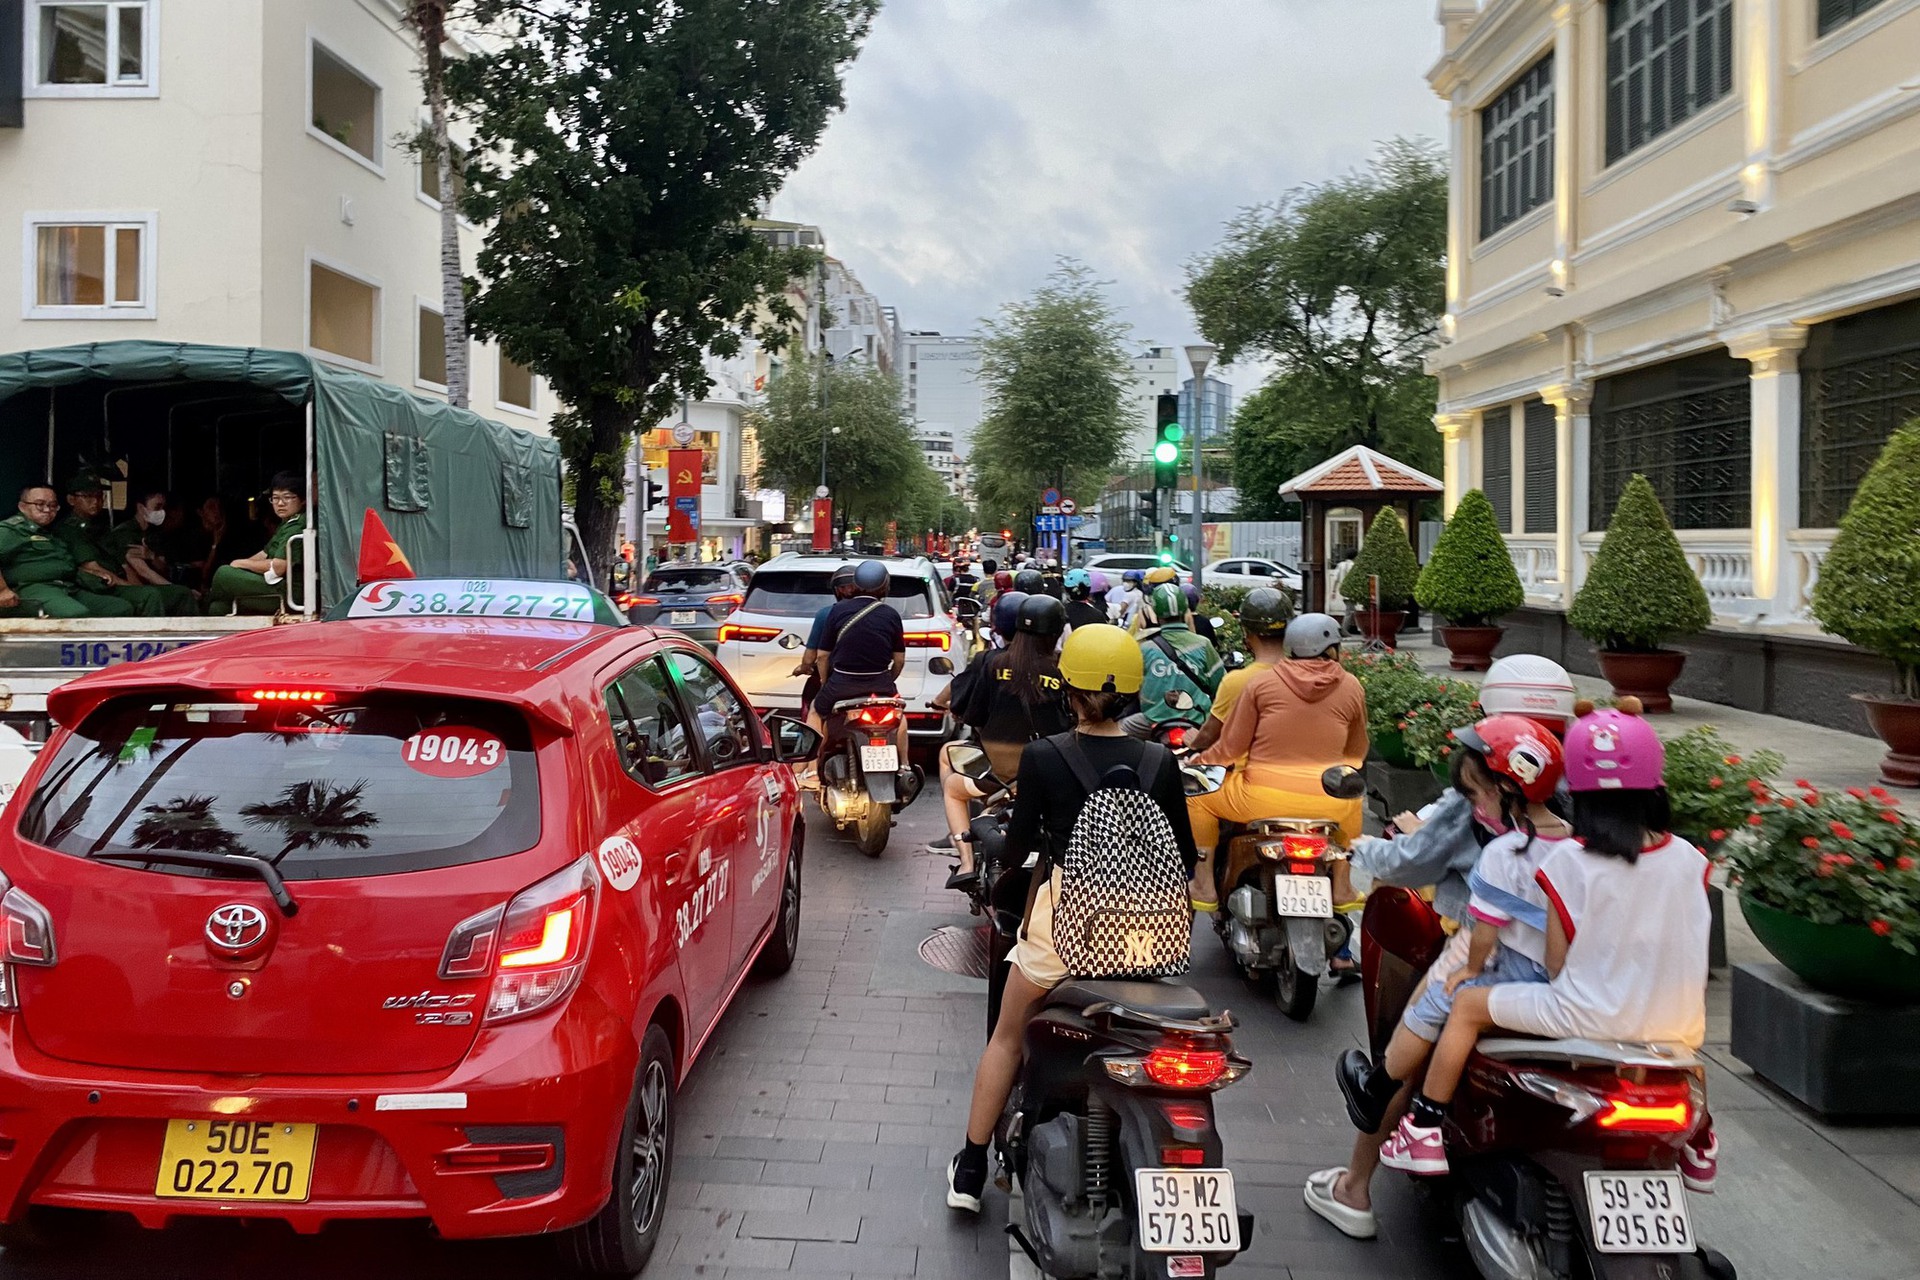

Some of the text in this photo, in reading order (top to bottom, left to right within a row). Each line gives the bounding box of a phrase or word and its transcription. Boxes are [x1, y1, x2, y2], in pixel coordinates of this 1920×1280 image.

[408, 592, 590, 619] 38.27 27 27
[407, 734, 501, 766] 19043
[602, 841, 640, 880] 19043
[1285, 879, 1323, 897] 71-B2
[206, 1120, 275, 1155] 50E
[173, 1158, 294, 1195] 022.70
[1600, 1179, 1672, 1210] 59-S3
[1148, 1212, 1232, 1245] 573.50
[1598, 1215, 1688, 1246] 295.69
